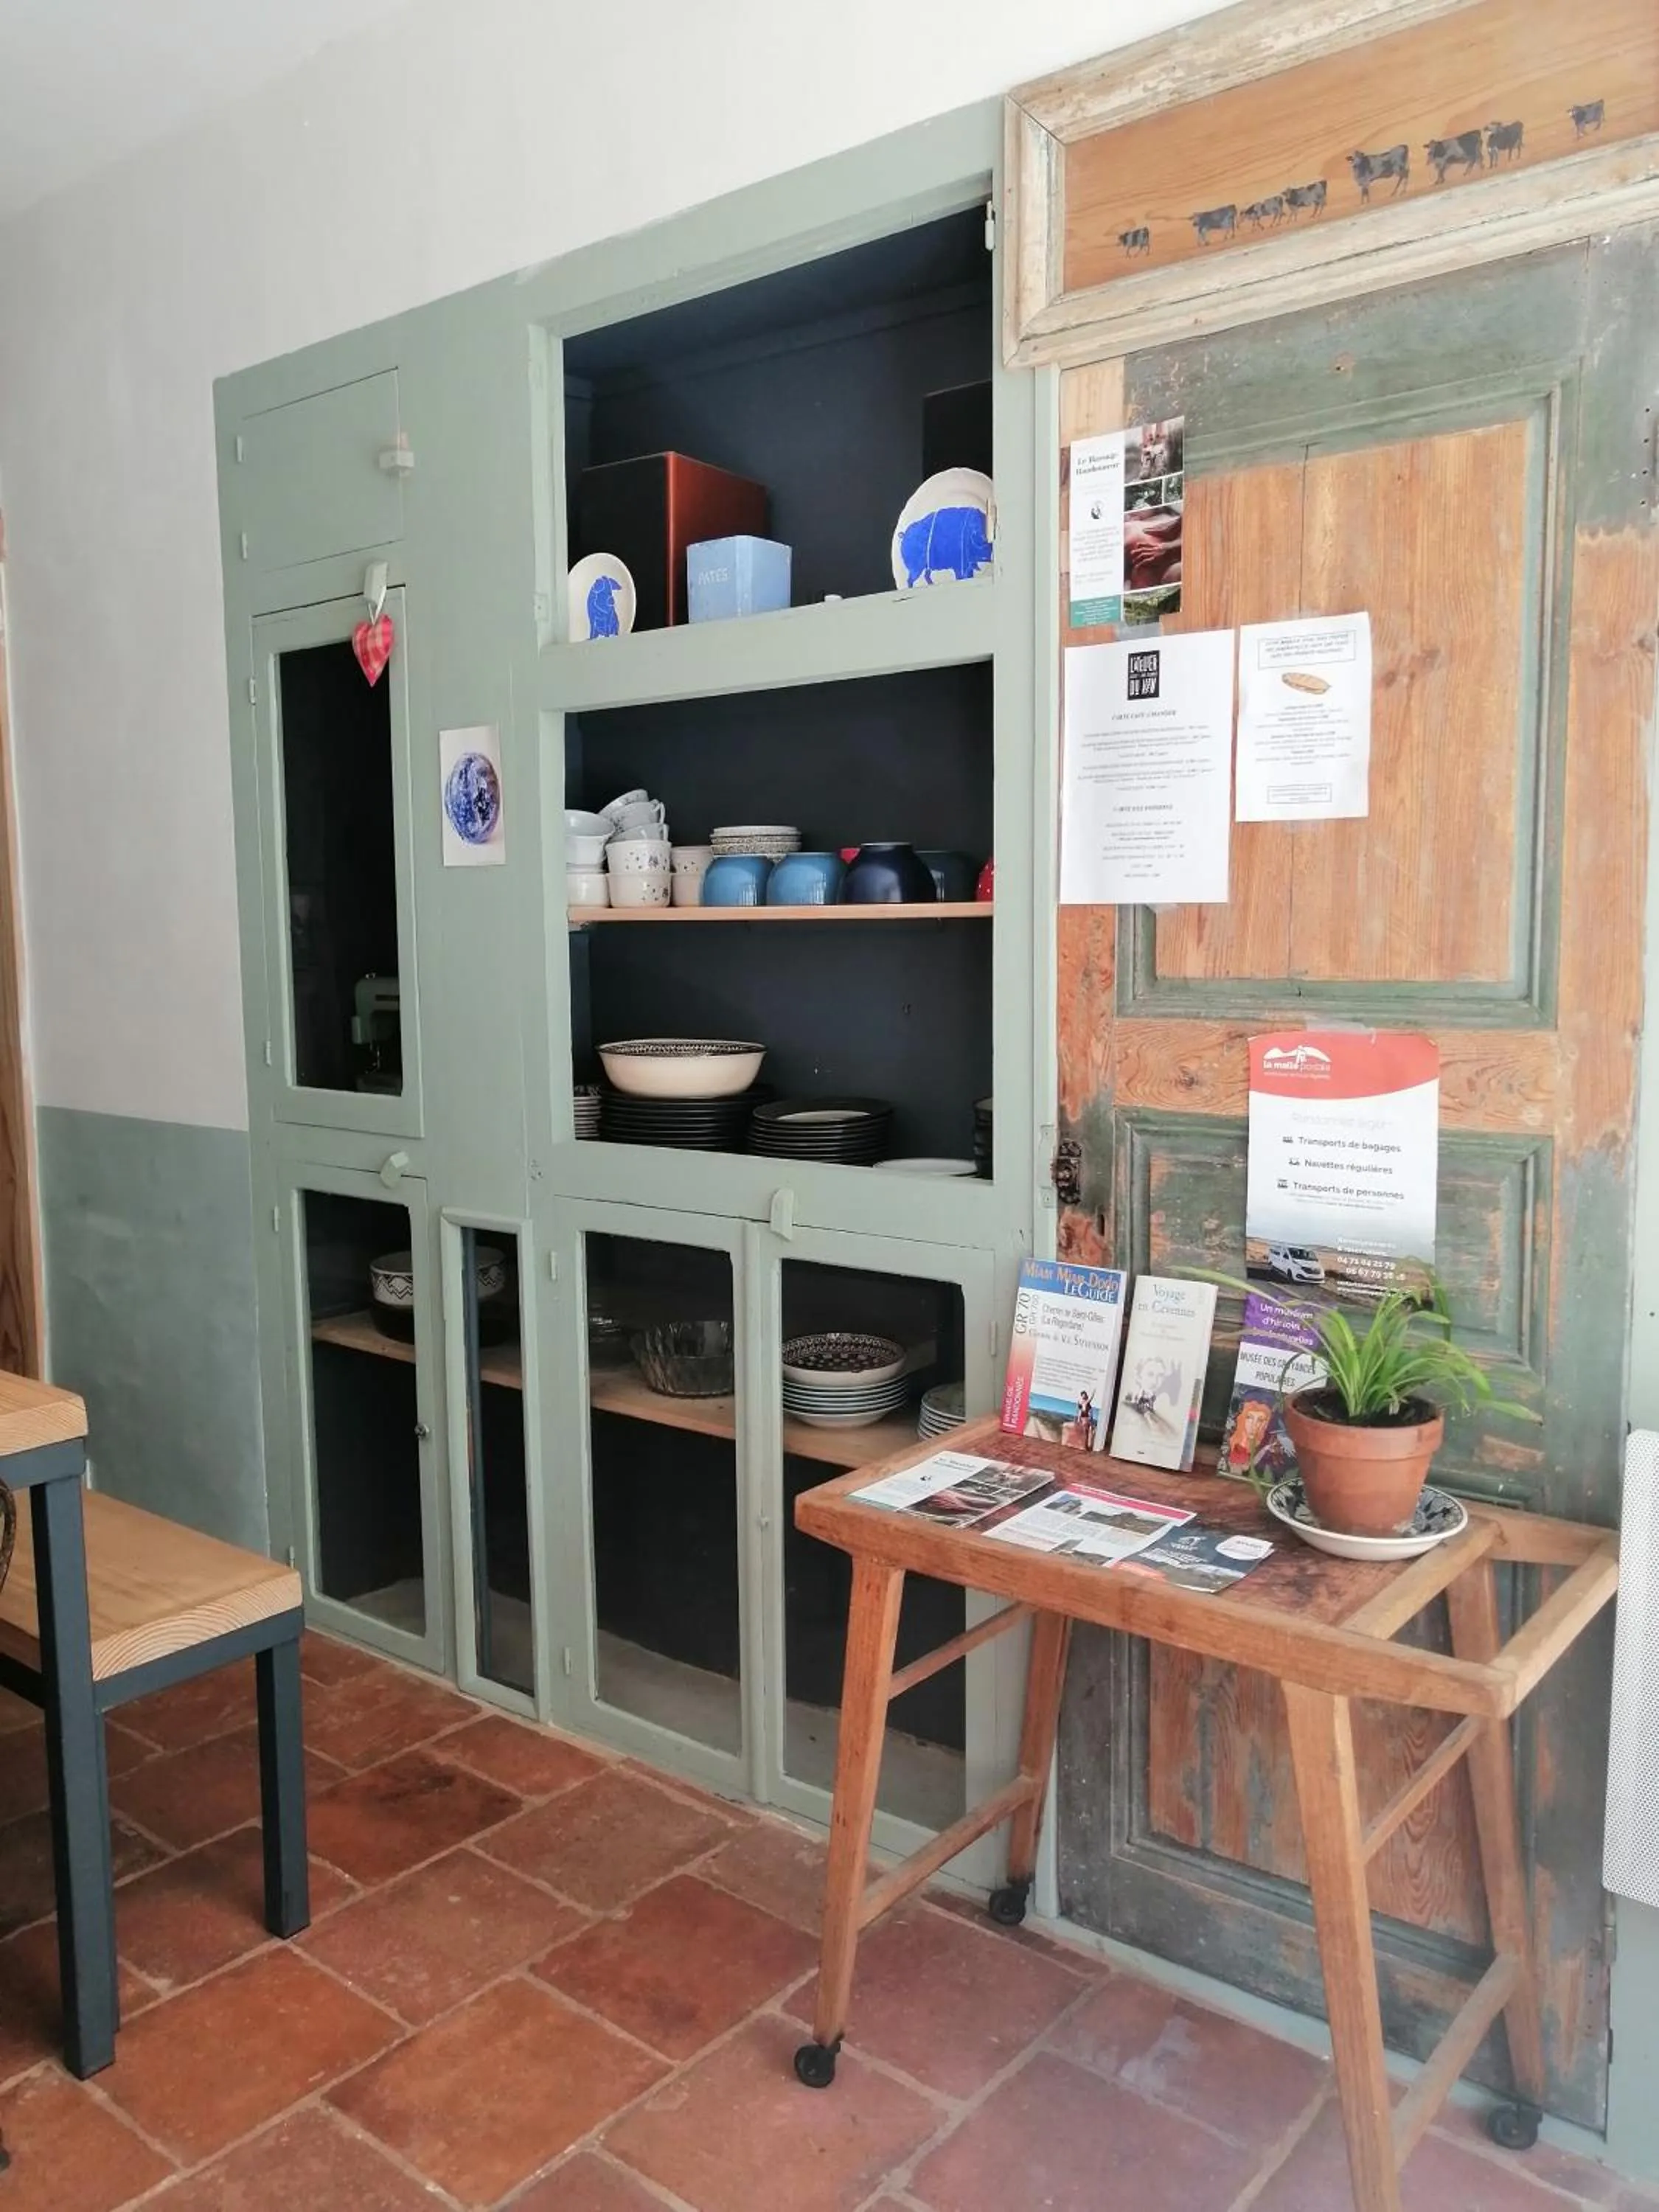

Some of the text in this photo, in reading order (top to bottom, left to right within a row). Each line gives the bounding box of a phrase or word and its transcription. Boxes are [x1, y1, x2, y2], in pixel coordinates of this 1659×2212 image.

[1263, 1060, 1272, 1068] la
[1298, 1136, 1402, 1153] Transports de bagages
[1304, 1158, 1393, 1174] Navettes régulières
[1293, 1181, 1340, 1193] Transports
[1343, 1186, 1354, 1194] de
[1356, 1188, 1405, 1200] personnes
[1153, 1284, 1186, 1303] Voyage
[1015, 1293, 1031, 1334] GR 70
[1260, 1304, 1273, 1312] Un
[1264, 1356, 1276, 1366] DES
[1256, 1371, 1295, 1387] POPULARES
